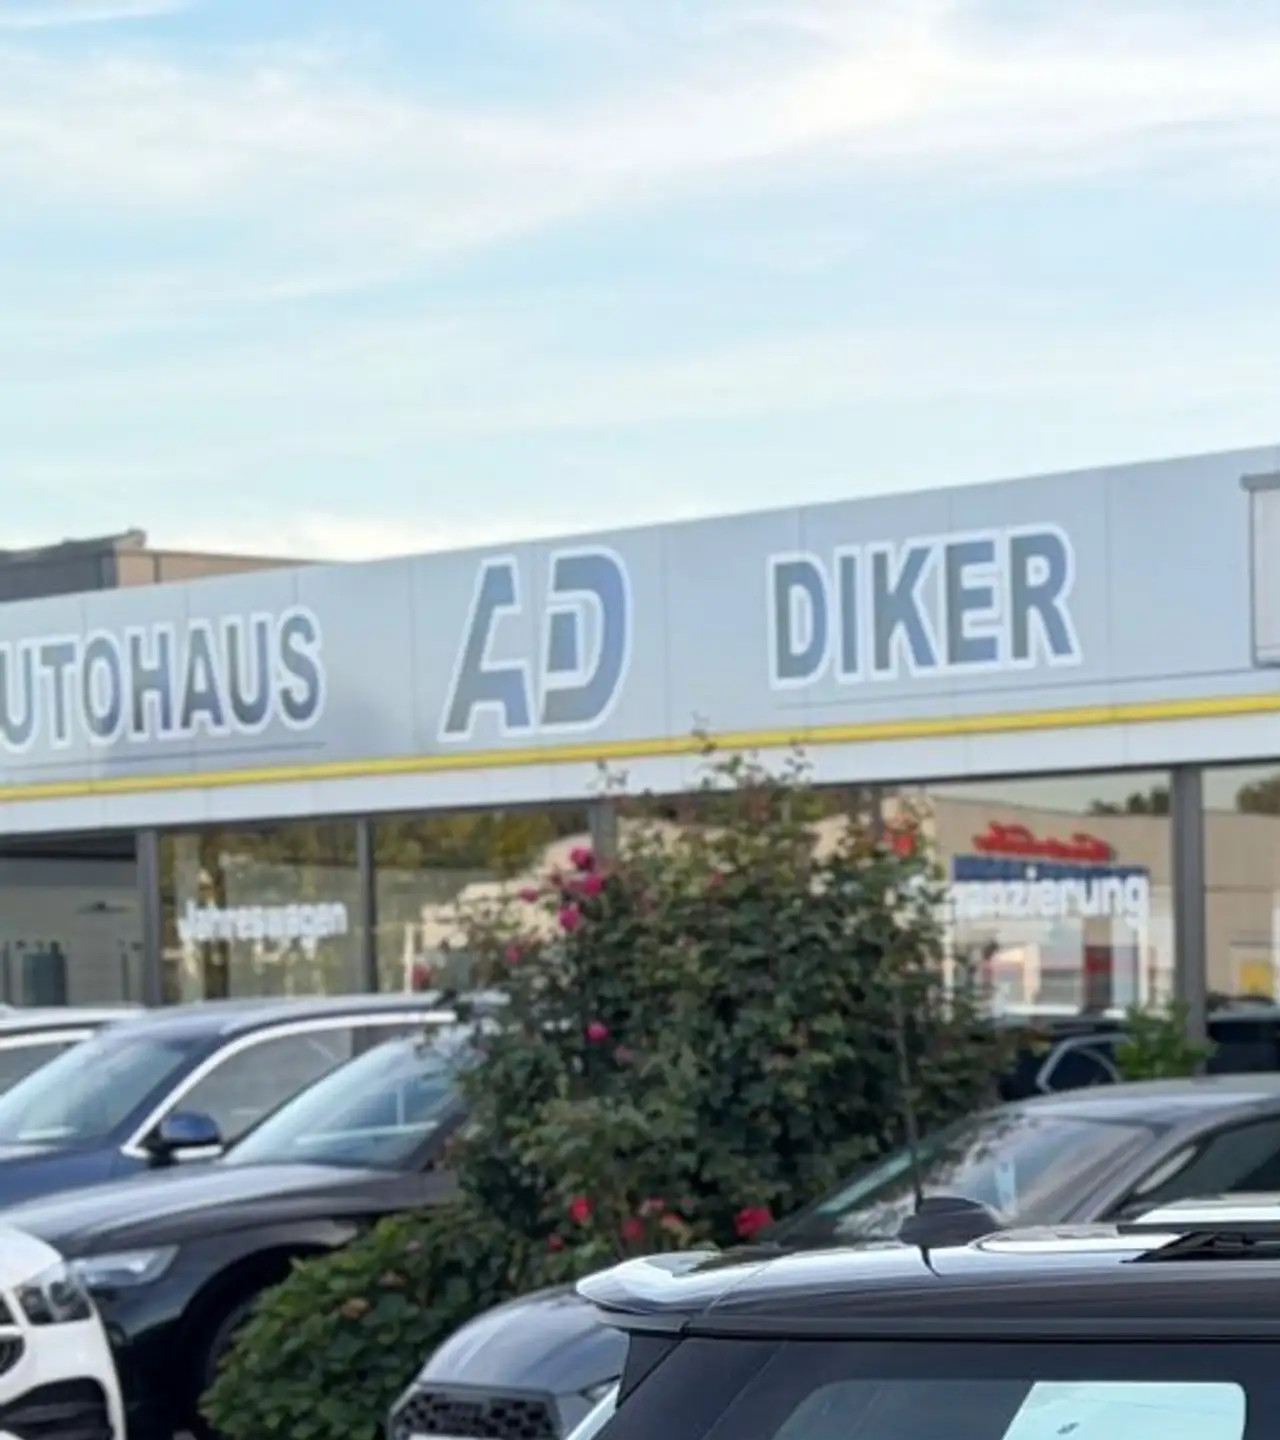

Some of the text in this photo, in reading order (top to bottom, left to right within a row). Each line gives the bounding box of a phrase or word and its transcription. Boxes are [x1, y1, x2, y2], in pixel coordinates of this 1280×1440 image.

[0, 523, 1079, 751] UTOHAUS AD DIKER
